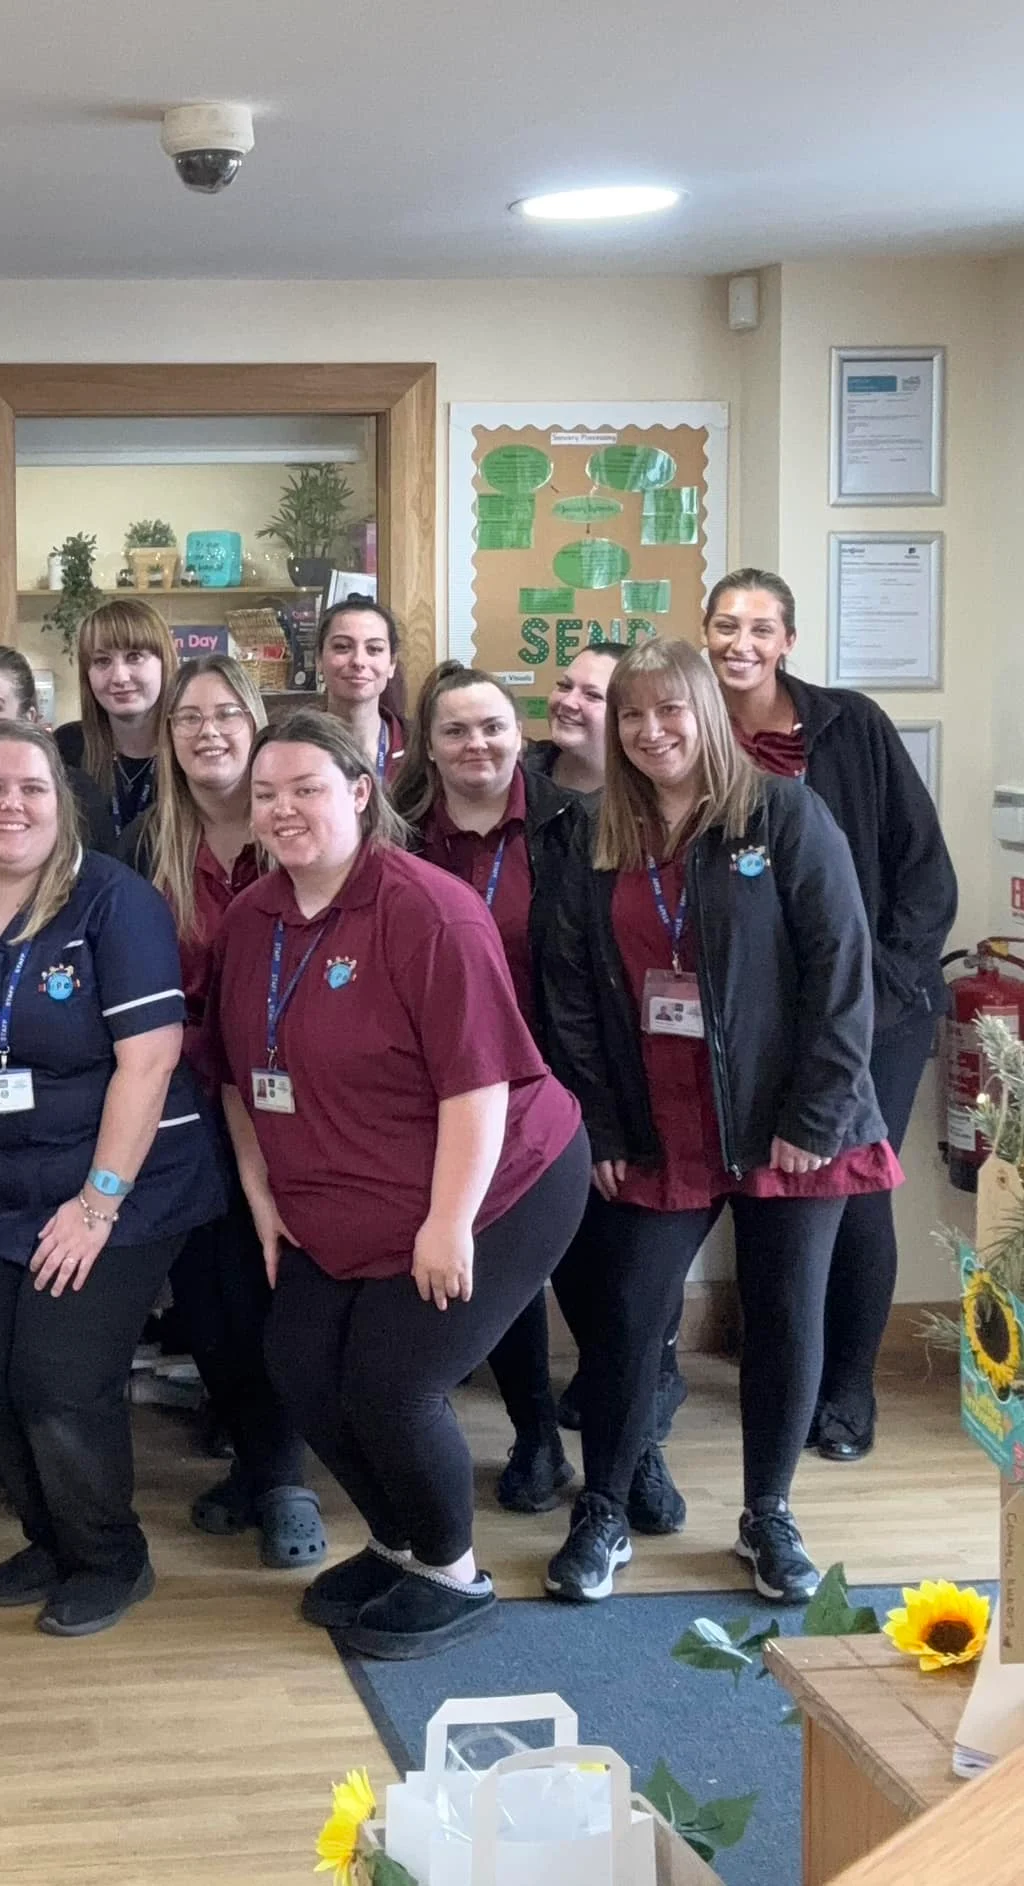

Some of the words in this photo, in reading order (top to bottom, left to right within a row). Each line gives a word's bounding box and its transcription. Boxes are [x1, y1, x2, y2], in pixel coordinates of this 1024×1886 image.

[188, 634, 218, 651] Day
[14, 953, 26, 974] STAFF
[6, 985, 14, 1006] STAFF
